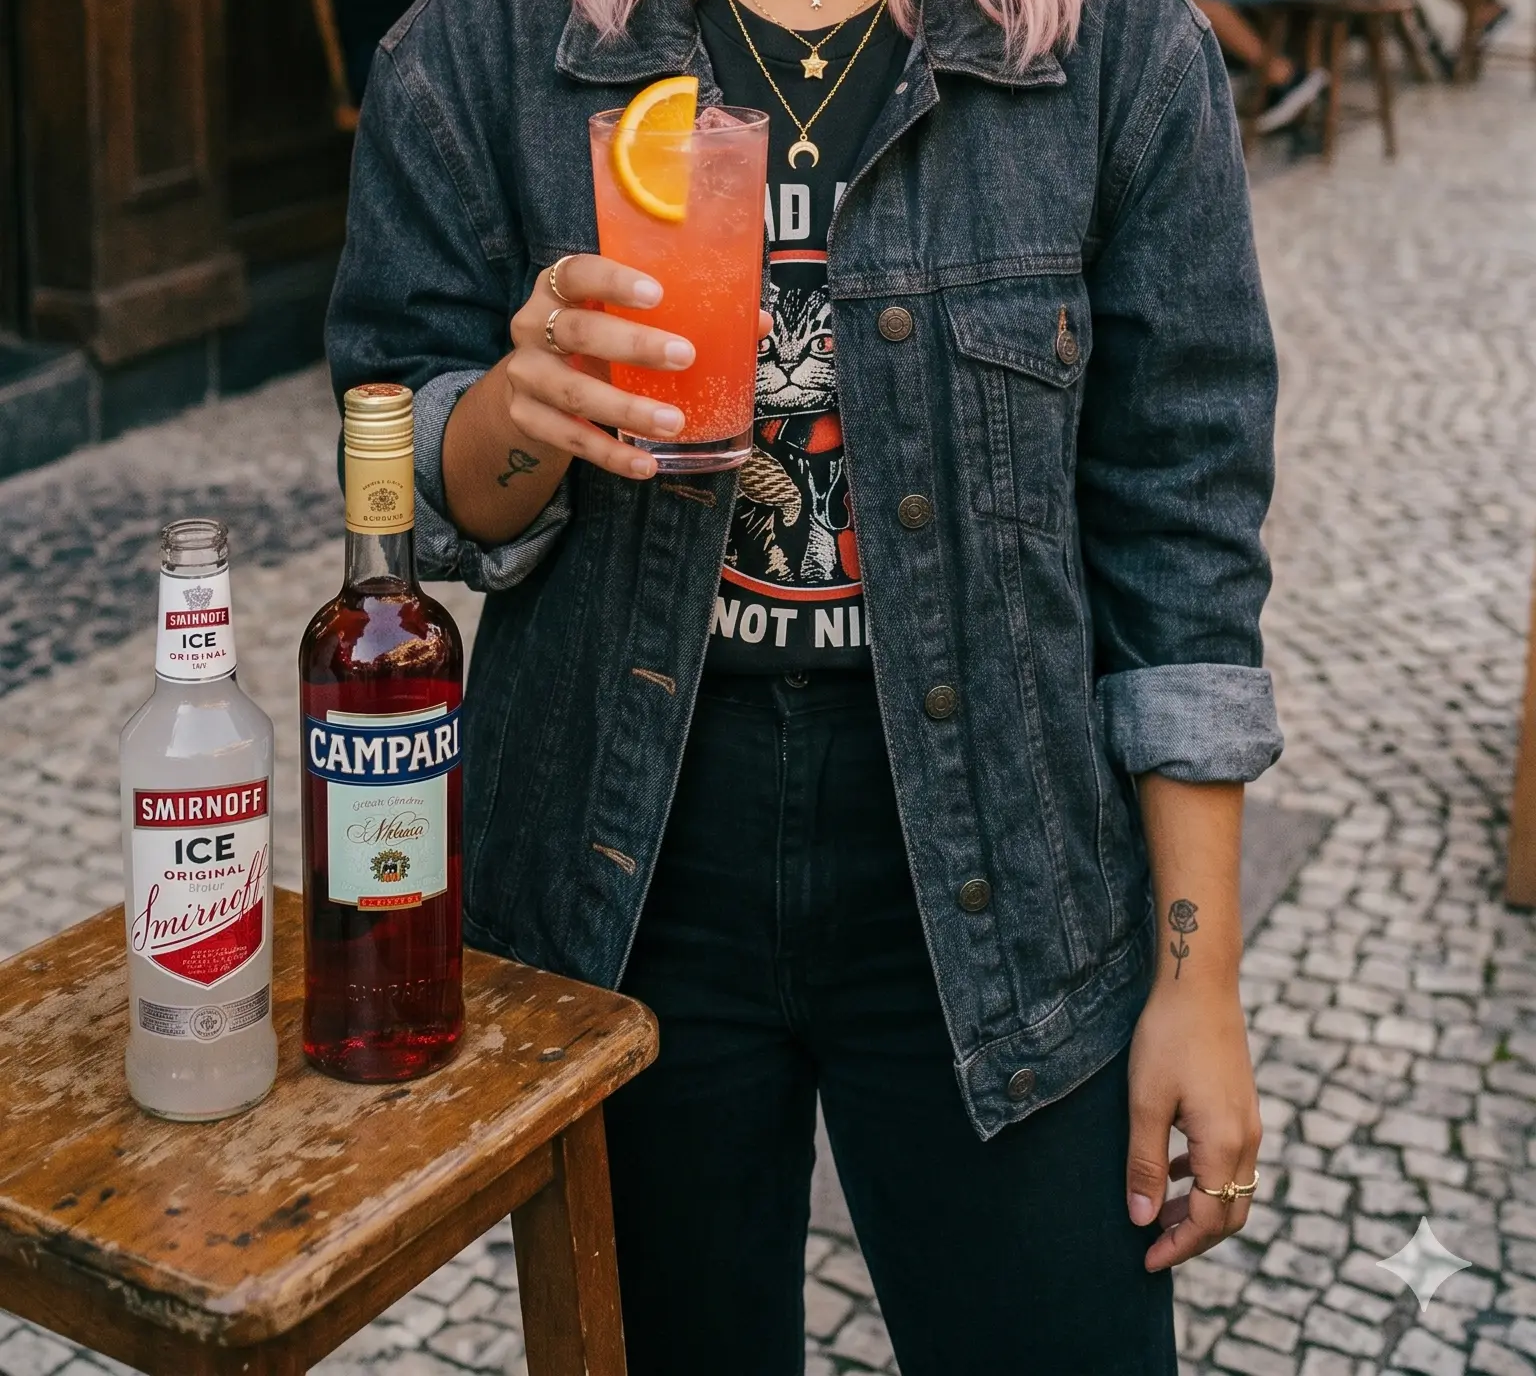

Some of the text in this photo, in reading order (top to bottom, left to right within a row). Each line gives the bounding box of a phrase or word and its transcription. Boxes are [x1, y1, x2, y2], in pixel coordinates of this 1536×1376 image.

[709, 596, 798, 647] NOT
[169, 649, 227, 660] ORIGINAL
[183, 632, 216, 648] ICE
[310, 717, 460, 775] CAMPARI
[142, 787, 262, 821] SMIRNOFF
[175, 833, 236, 864] ICE
[164, 864, 245, 881] ORIGINAL
[131, 843, 269, 952] Smirnoff
